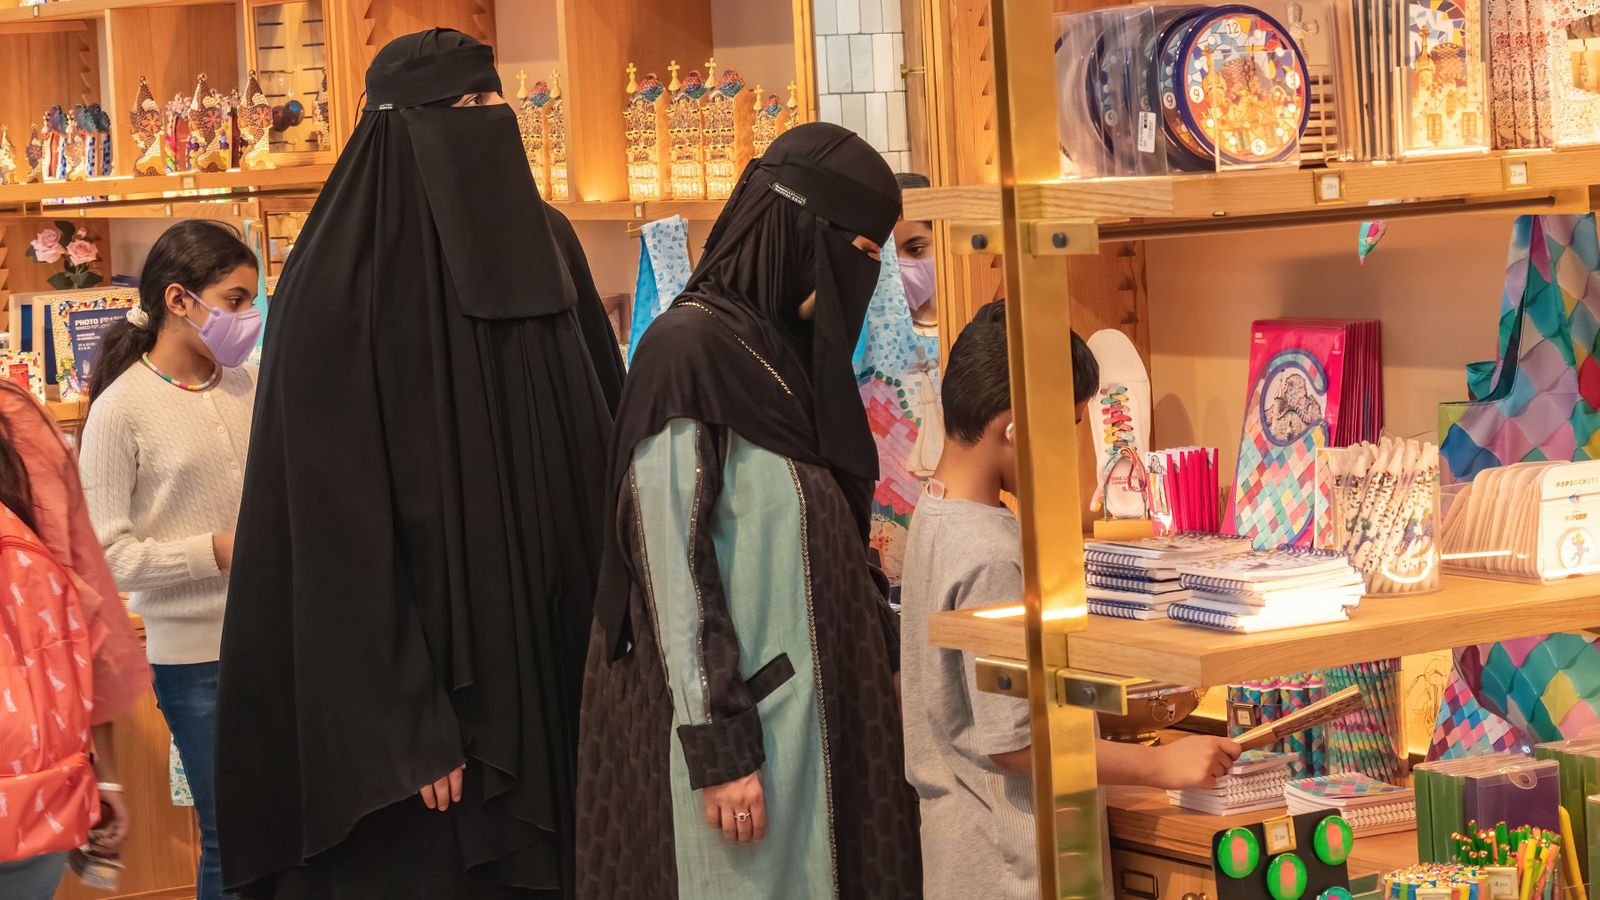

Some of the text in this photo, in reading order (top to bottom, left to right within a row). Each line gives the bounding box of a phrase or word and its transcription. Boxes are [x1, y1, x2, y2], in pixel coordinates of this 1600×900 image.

[1226, 22, 1239, 34] 12
[1166, 94, 1173, 107] 9
[1194, 88, 1200, 101] 9
[1255, 141, 1263, 153] 6
[74, 318, 99, 326] PHOTO
